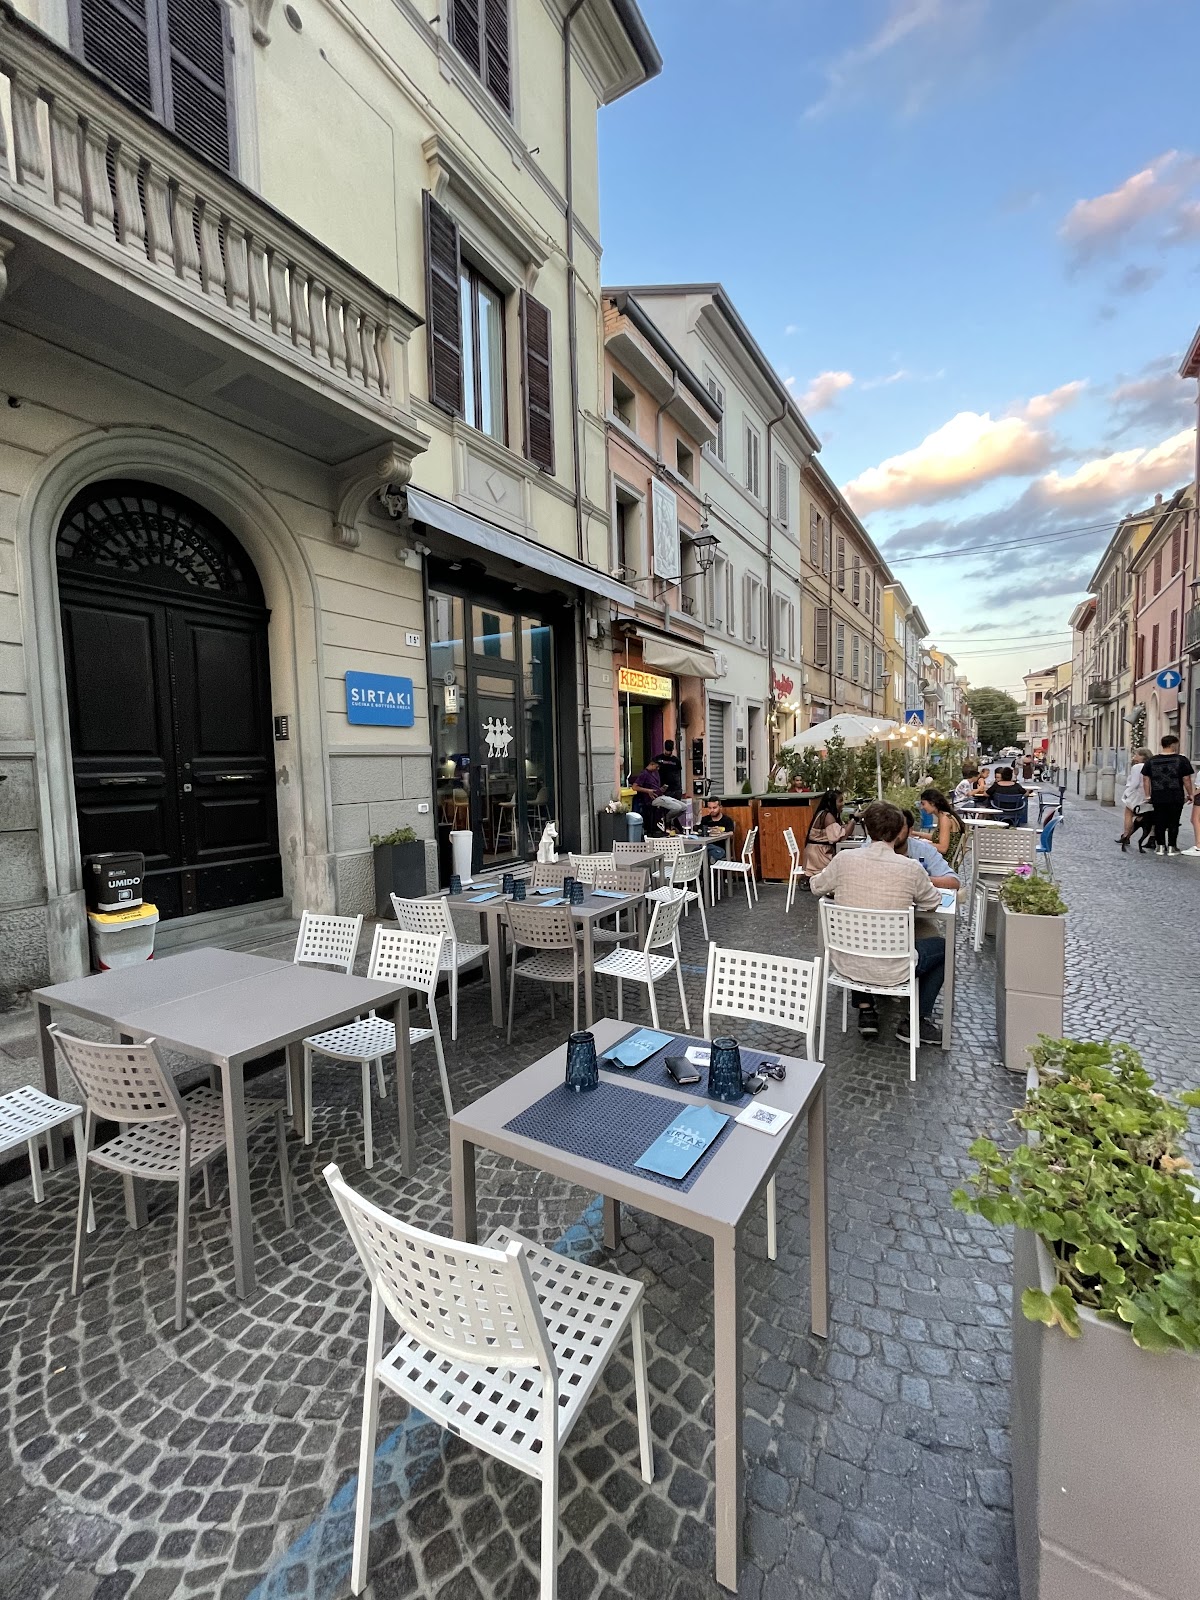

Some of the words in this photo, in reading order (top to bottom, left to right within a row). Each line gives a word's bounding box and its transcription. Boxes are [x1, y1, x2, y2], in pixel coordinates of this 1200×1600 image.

[620, 670, 658, 690] KEBAB
[351, 688, 411, 705] SIRTAKI
[108, 877, 140, 888] UMIDO
[666, 1129, 707, 1149] SIRTAKI
